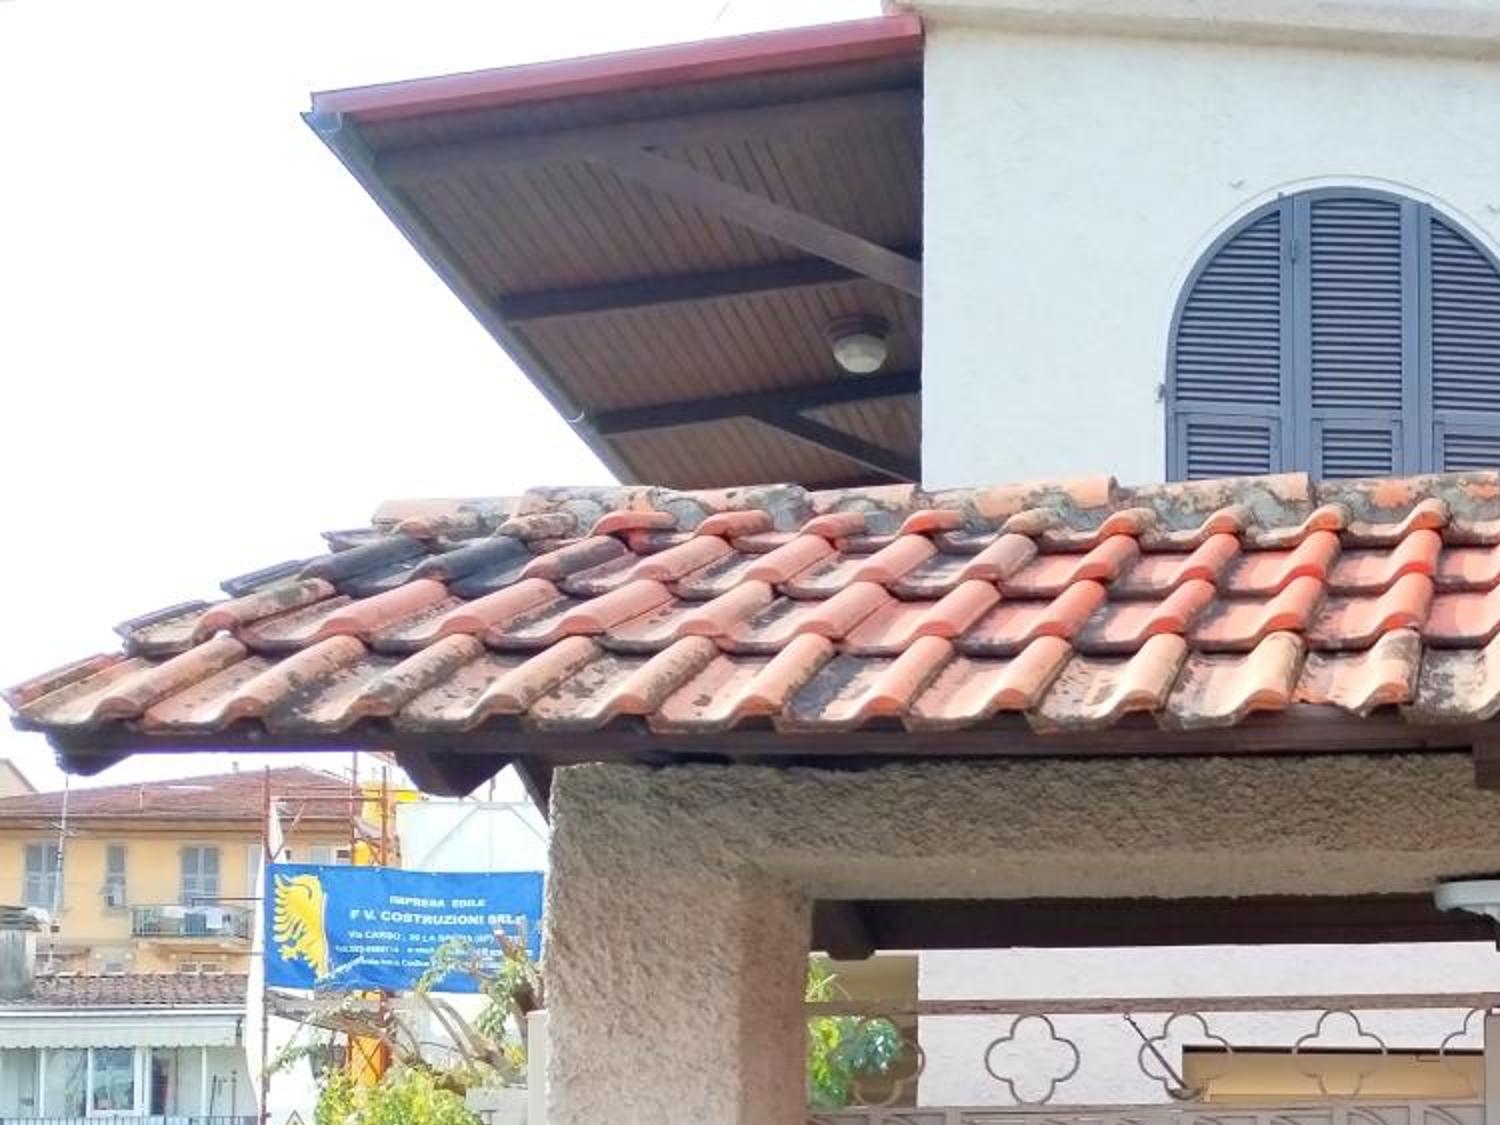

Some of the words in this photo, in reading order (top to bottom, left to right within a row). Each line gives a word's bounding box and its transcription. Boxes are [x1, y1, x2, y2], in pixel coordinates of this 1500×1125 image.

[390, 895, 445, 908] IMPRESA
[452, 898, 486, 909] EDILE
[380, 911, 484, 925] COSTRUZIONI
